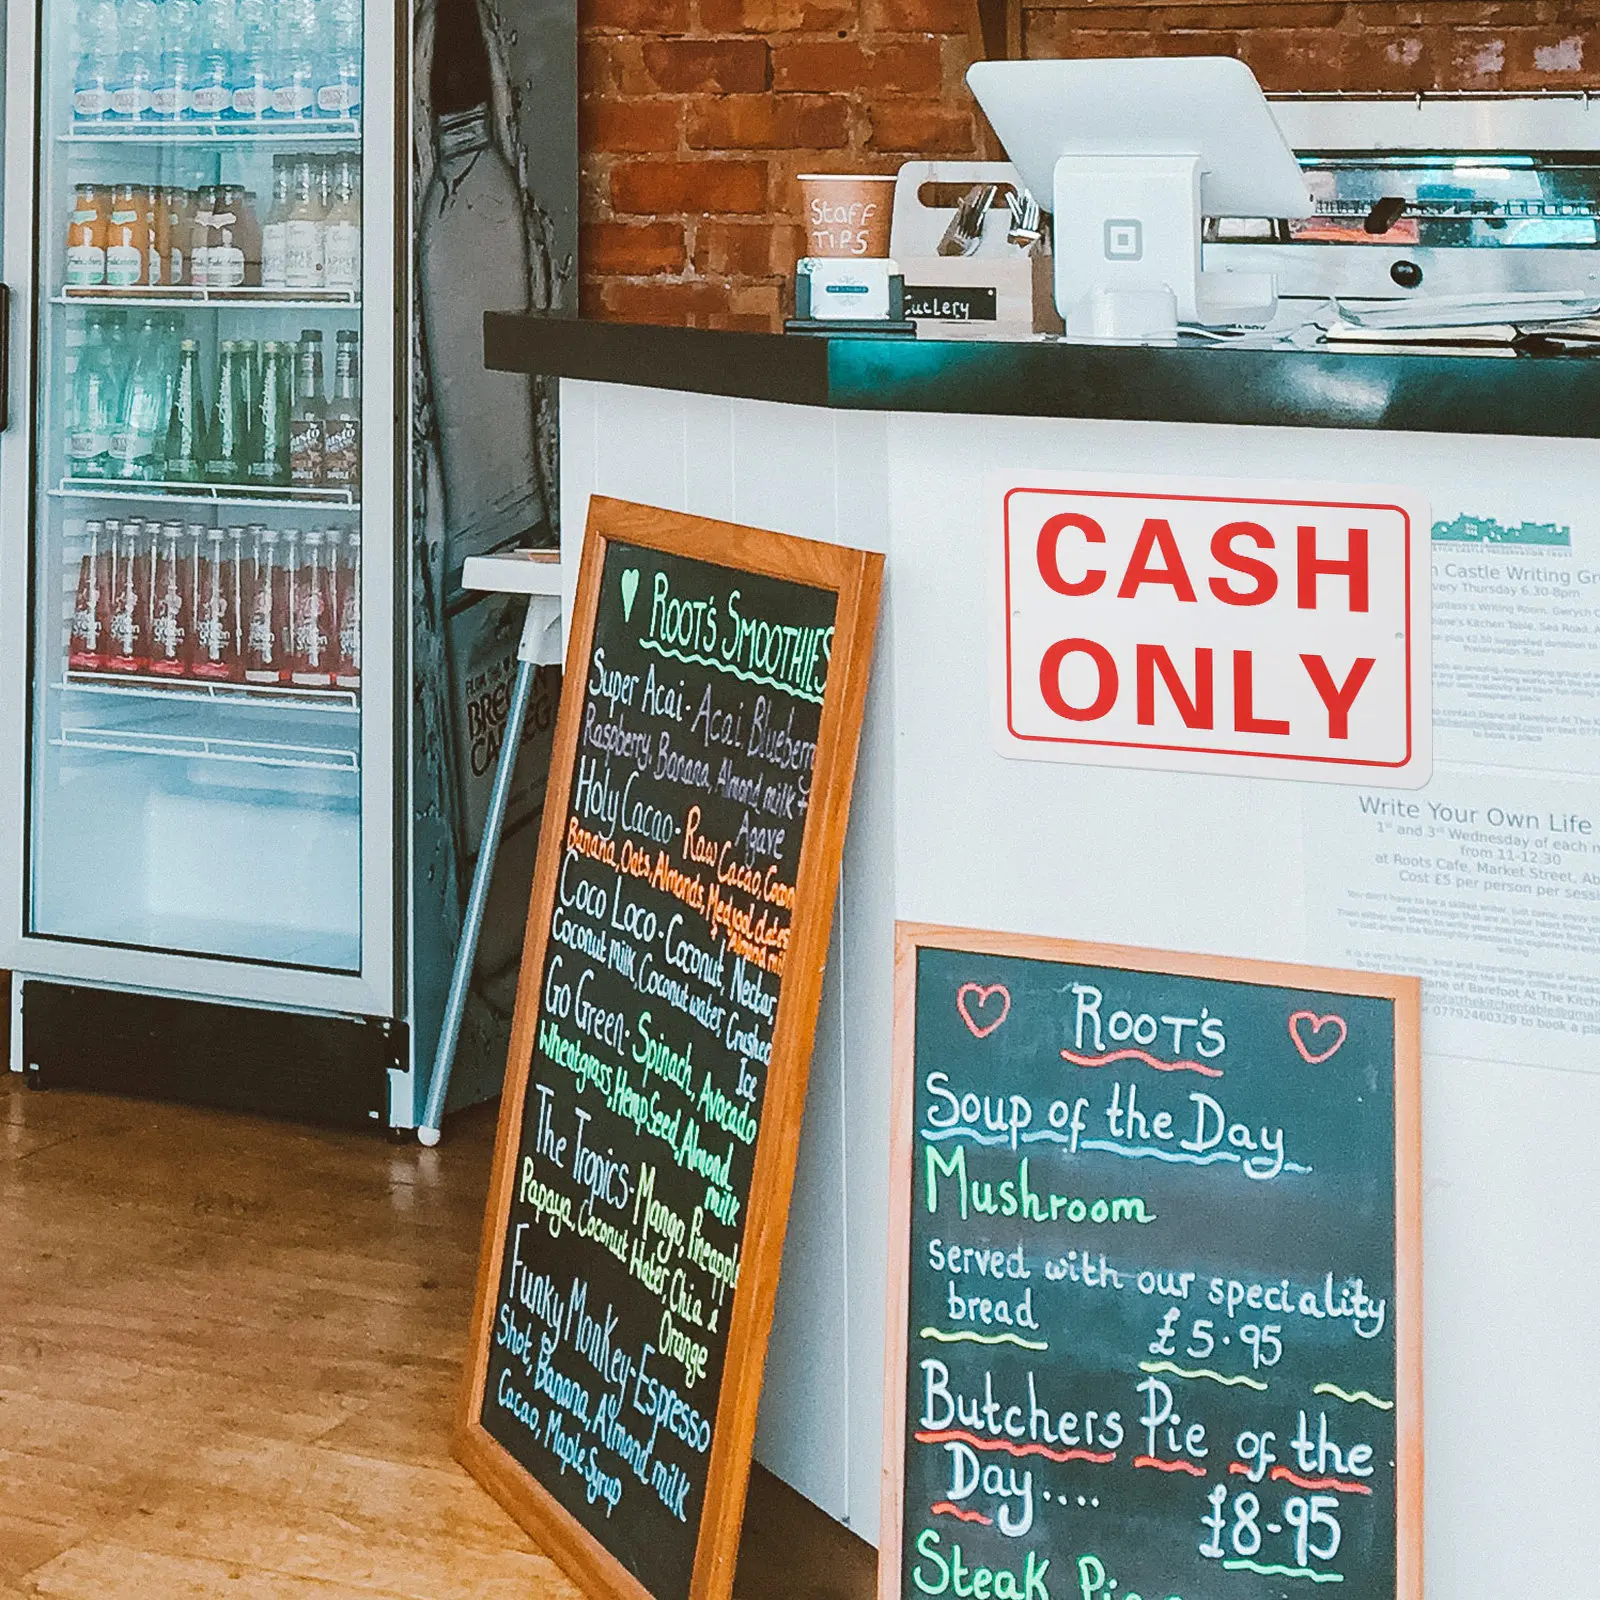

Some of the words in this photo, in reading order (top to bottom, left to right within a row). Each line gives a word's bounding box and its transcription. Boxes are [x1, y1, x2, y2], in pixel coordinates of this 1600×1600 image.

[1036, 513, 1369, 613] CASH
[1432, 583, 1457, 593] very
[1462, 583, 1517, 597] Thursday
[1445, 563, 1500, 579] Castle
[1506, 566, 1570, 586] Writing
[1577, 569, 1600, 584] Gr
[588, 648, 640, 718] Super
[747, 695, 818, 792] Blueberr
[1039, 638, 1376, 740] ONLY
[574, 755, 620, 840] Holy
[621, 771, 674, 844] Cacao
[683, 805, 717, 867] Raw
[764, 784, 793, 820] milk
[1359, 795, 1420, 819] Write
[1427, 801, 1479, 823] Your
[1486, 807, 1539, 830] Own
[1549, 813, 1593, 835] Life
[735, 811, 786, 869] Agave
[1375, 854, 1389, 864] at
[1393, 853, 1432, 869] Roots
[1477, 862, 1525, 878] Market
[1396, 824, 1423, 837] and
[1448, 828, 1529, 849] Wednesday
[1534, 836, 1549, 848] of
[1552, 840, 1588, 853] each
[1459, 844, 1493, 859] from
[559, 850, 607, 919] Coco
[611, 875, 657, 942] Loco
[1399, 870, 1430, 884] Cost
[1455, 877, 1479, 889] per
[1483, 879, 1532, 895] person
[1536, 885, 1559, 897] per
[552, 908, 607, 964] Coconut
[639, 952, 689, 1010] Coconut
[1521, 1017, 1533, 1027] to
[1537, 1018, 1566, 1030] book
[1540, 991, 1563, 1003] The
[545, 955, 571, 1018] Go
[575, 968, 625, 1056] Green
[697, 1071, 757, 1144] Avocado
[735, 1057, 758, 1102] Ice
[612, 1067, 649, 1136] Hemp
[925, 1071, 1032, 1151] Soup
[1048, 1097, 1091, 1154] of
[1106, 1082, 1174, 1140] the
[1180, 1092, 1286, 1180] Day
[535, 1084, 567, 1168] The
[573, 1107, 629, 1215] Tropics
[678, 1118, 734, 1190] Almond
[924, 1144, 1157, 1223] Mushroom
[704, 1186, 741, 1227] milk
[577, 1199, 629, 1263] Coconut
[670, 1268, 702, 1327] Chia
[1044, 1250, 1124, 1291] with
[1136, 1270, 1195, 1300] our
[1208, 1272, 1386, 1339] speciality
[948, 1280, 1039, 1330] bread
[659, 1310, 708, 1389] Orange
[920, 1358, 1124, 1448] Butchers
[1136, 1376, 1208, 1458] Pie
[1235, 1429, 1277, 1482] of
[1289, 1408, 1375, 1477] the
[544, 1410, 585, 1475] Maple
[584, 1447, 622, 1519] Syrup
[592, 1393, 653, 1485] Almond
[651, 1460, 690, 1523] milk
[912, 1528, 1051, 1600] Steak
